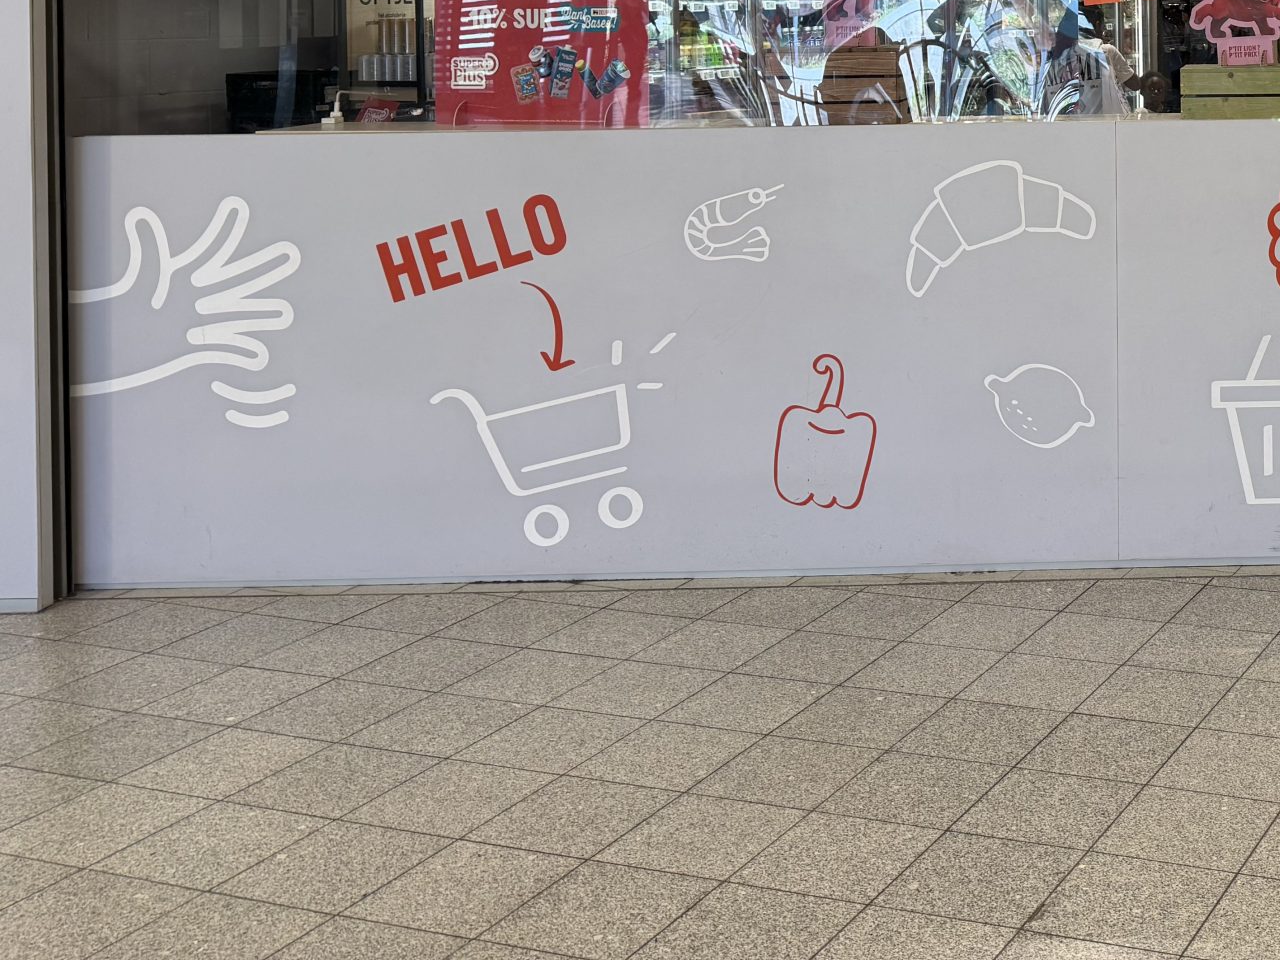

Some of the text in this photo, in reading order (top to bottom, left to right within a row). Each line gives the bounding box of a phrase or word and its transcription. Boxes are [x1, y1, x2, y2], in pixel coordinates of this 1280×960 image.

[513, 8, 552, 29] SUR
[453, 68, 484, 83] Plus
[376, 193, 567, 303] HELLO
